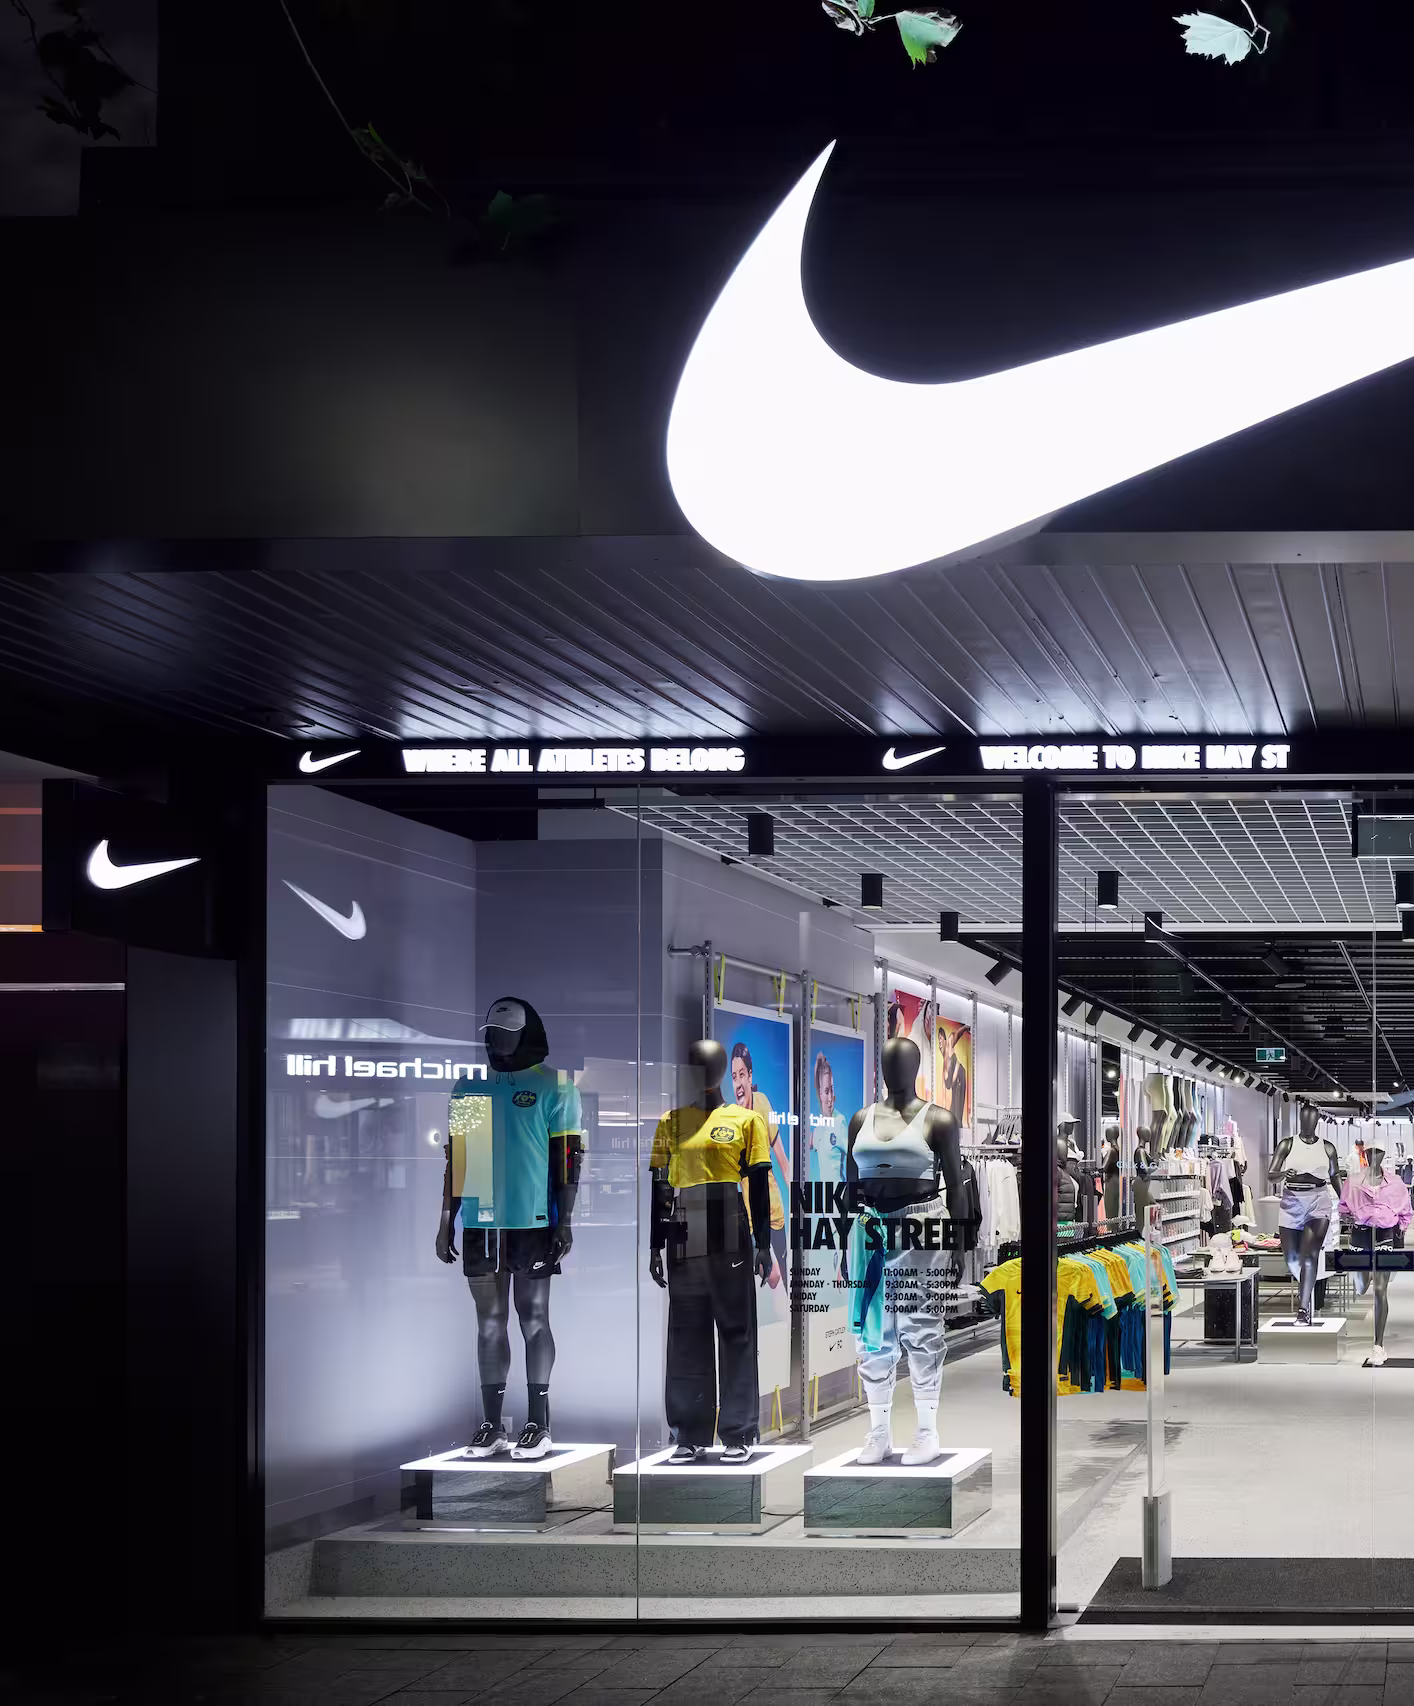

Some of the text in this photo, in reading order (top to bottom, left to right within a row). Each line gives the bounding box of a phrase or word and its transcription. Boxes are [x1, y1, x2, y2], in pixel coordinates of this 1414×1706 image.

[402, 747, 746, 772] WHERE ALL ATHLETES BELONG
[979, 744, 1291, 770] WELCOME TO NIKE HAY ST
[790, 1182, 865, 1213] NIKE
[790, 1218, 977, 1250] HAY STREET
[925, 1268, 959, 1277] 5:00PM
[885, 1280, 918, 1289] 9:30AM
[926, 1280, 959, 1289] 5:30PM
[884, 1292, 918, 1301] 9:30AM
[926, 1292, 959, 1301] 9:00PM
[789, 1304, 830, 1313] SATURDAY
[884, 1304, 918, 1313] 9:00AM
[926, 1304, 959, 1313] 5:00PM
